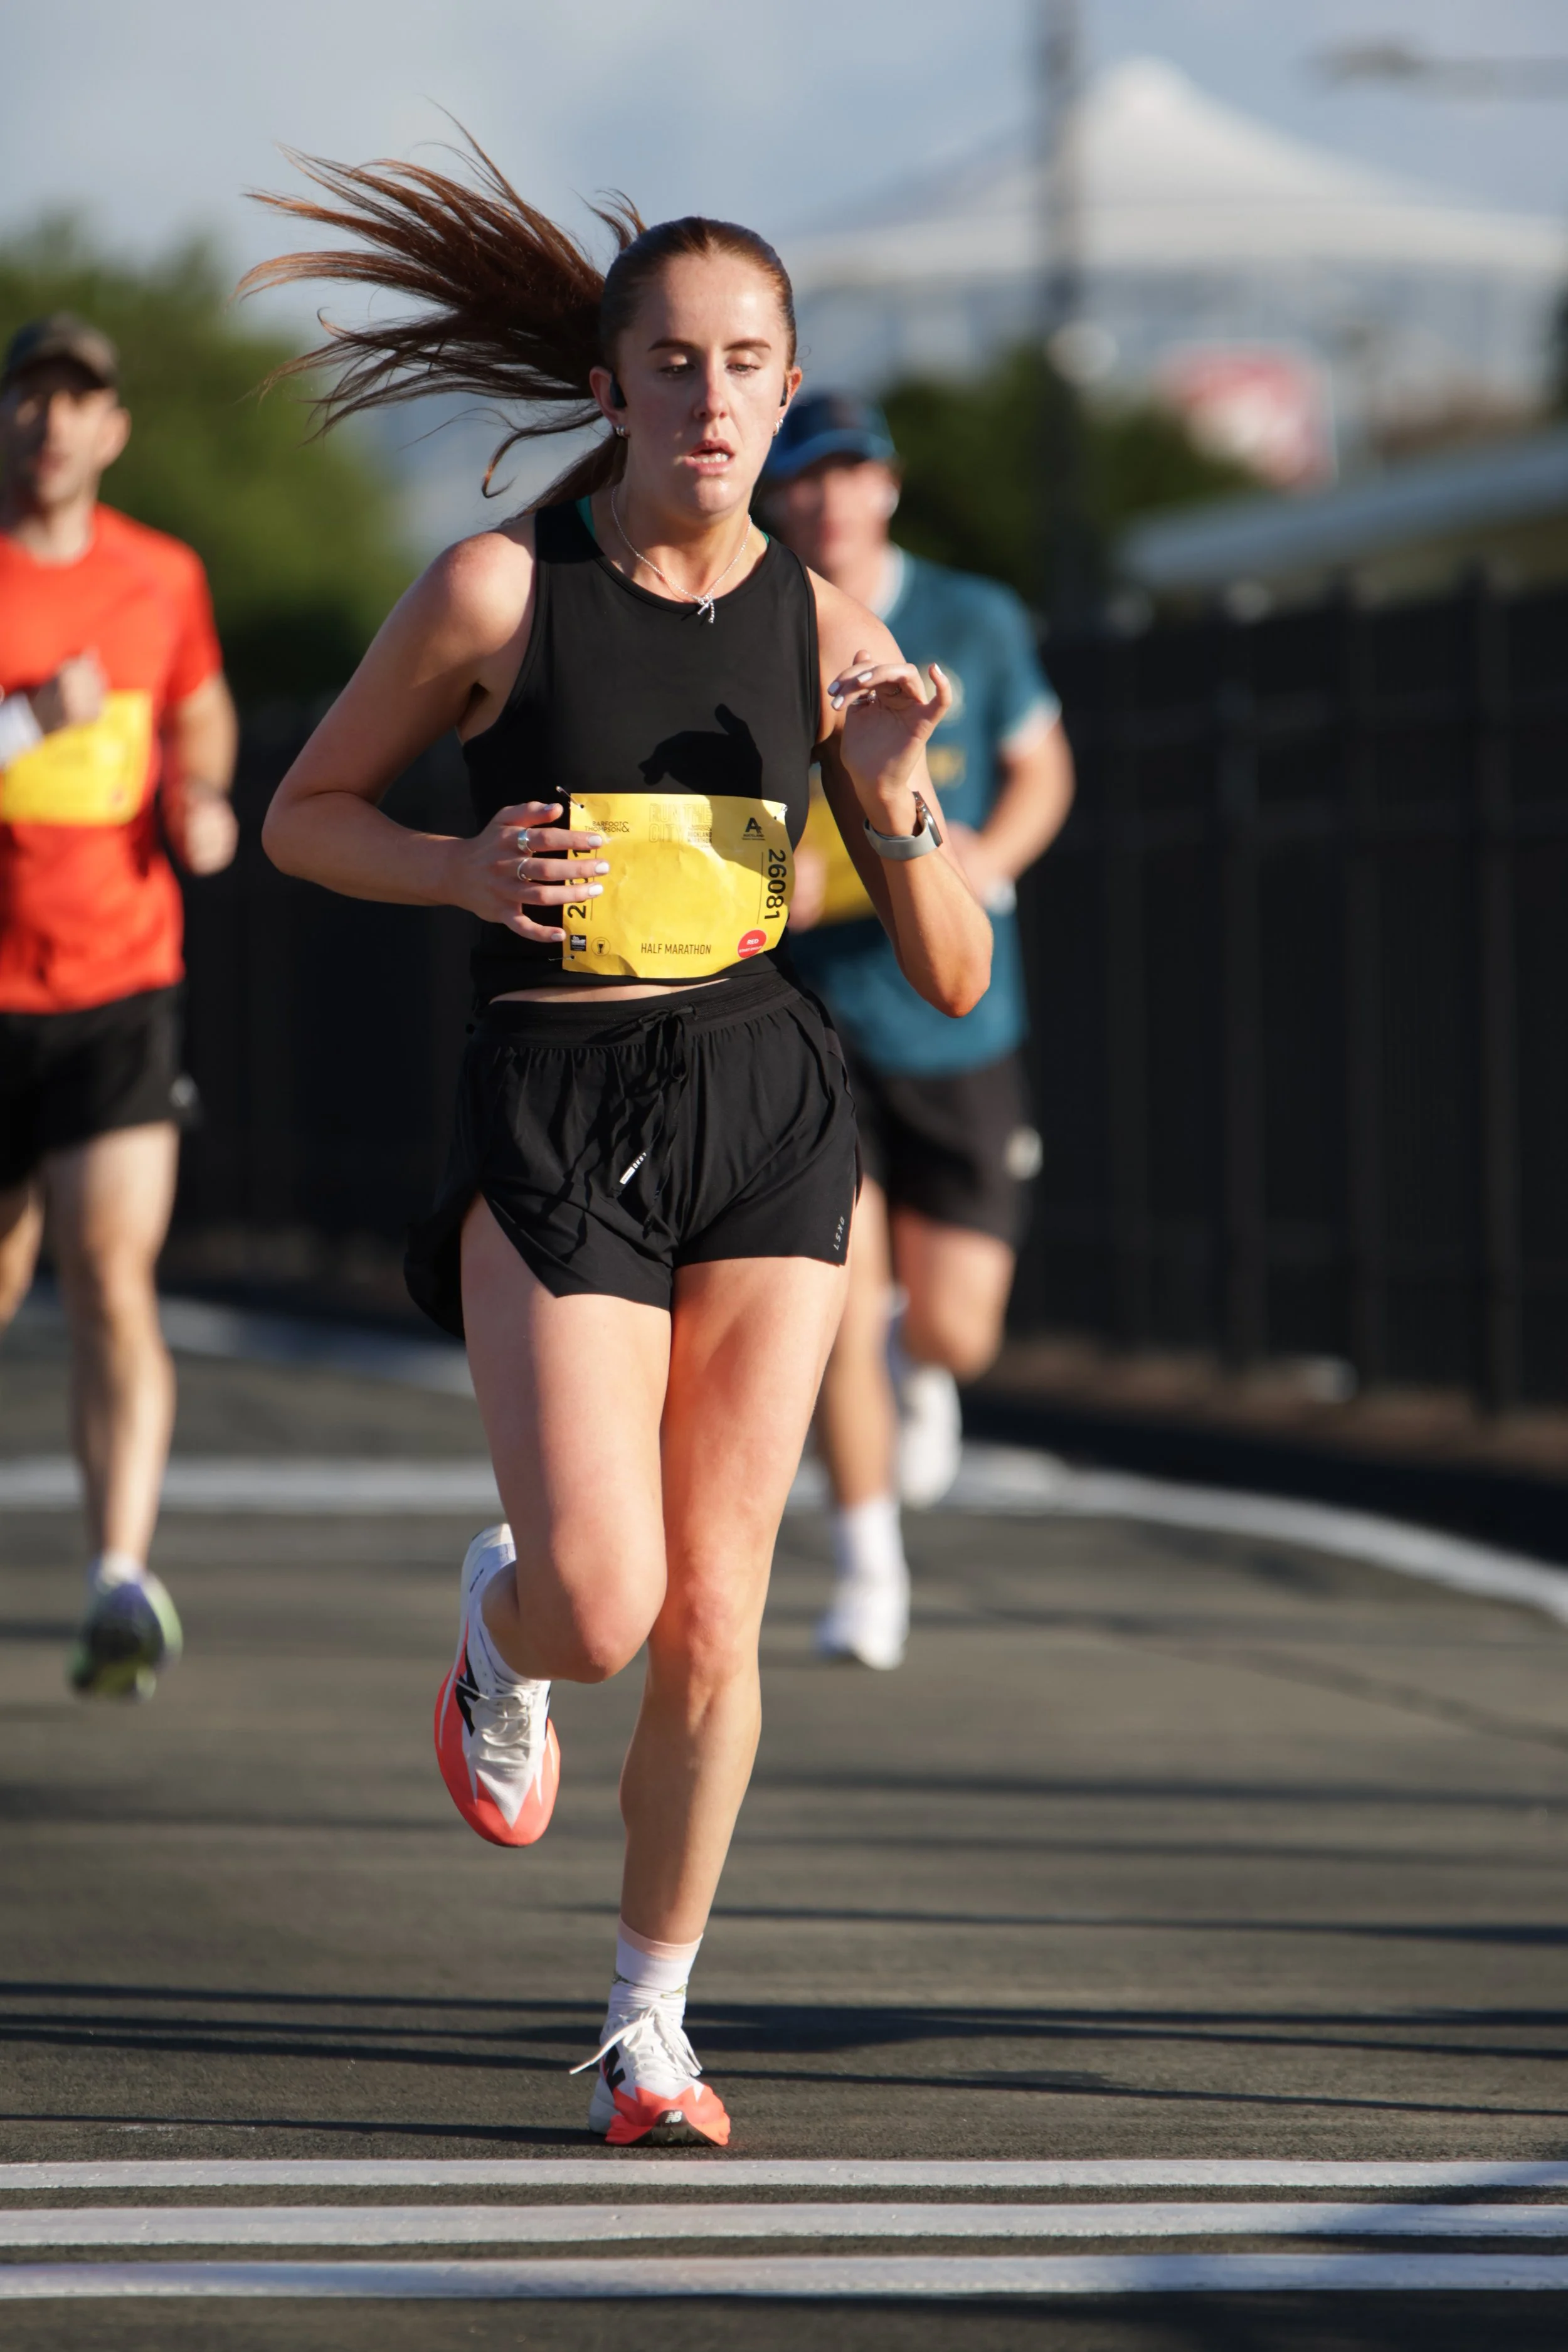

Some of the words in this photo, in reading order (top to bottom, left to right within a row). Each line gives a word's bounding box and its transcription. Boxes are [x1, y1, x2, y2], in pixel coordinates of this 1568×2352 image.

[622, 821, 630, 832] &
[764, 849, 787, 919] 26081
[641, 943, 662, 953] HALF
[665, 943, 711, 954] MARATHON
